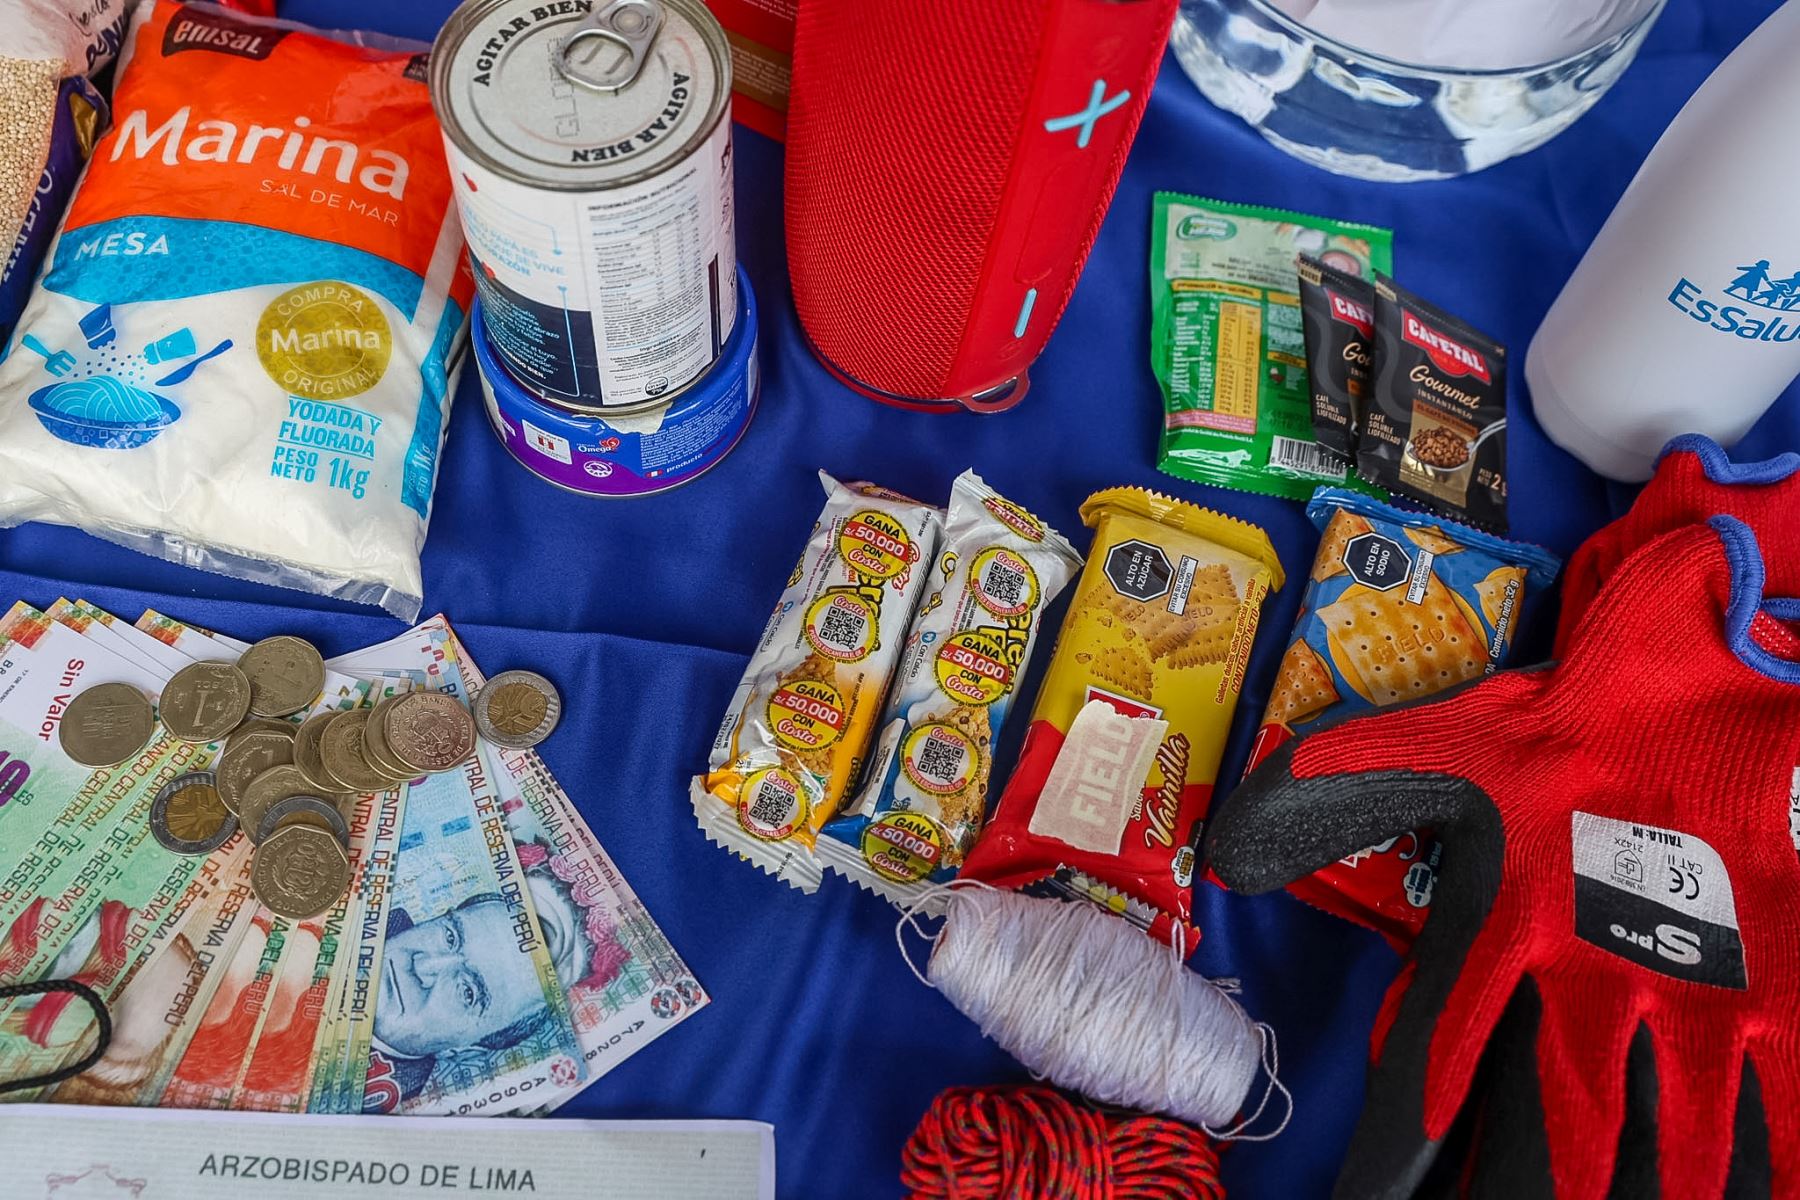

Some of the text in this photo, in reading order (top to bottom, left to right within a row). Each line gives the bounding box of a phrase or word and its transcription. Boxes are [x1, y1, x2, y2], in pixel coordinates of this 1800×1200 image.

[474, 17, 530, 86] AGITAR
[534, 0, 592, 20] BIEN
[571, 71, 690, 162] AGITAR BIEN
[110, 107, 410, 200] Marina
[259, 178, 399, 227] SAL DE MAR
[74, 232, 170, 262] MESA
[276, 286, 364, 316] COMPRA
[271, 324, 382, 354] Marina
[1407, 316, 1484, 373] CAFETAL
[283, 366, 377, 394] ORIGINAL
[1408, 364, 1482, 410] Gourmet
[287, 398, 382, 436] YODADA Y
[1315, 400, 1340, 415] SOLUBLE
[1369, 411, 1386, 424] CAFÉ
[278, 421, 375, 458] FLUORADA
[1367, 429, 1401, 446] LIOFILIZADO
[1368, 420, 1394, 435] SOLUBLE
[273, 446, 318, 467] PESO
[270, 461, 316, 483] NETO
[328, 457, 371, 499] 1kg
[1490, 474, 1501, 490] 2
[855, 526, 904, 556] 50,000
[864, 515, 901, 539] GANA
[848, 548, 886, 574] Costa
[862, 543, 884, 558] CON
[995, 552, 1025, 574] Costa
[1364, 542, 1381, 577] ALTO EN
[1376, 550, 1391, 577] SODIO
[1125, 550, 1143, 587] ALTO EN
[1136, 555, 1154, 590] AZÚCAR
[1504, 586, 1516, 598] 32
[1510, 579, 1520, 587] g
[834, 595, 865, 617] Costa
[1232, 605, 1250, 633] artificial
[1501, 598, 1513, 617] neto
[919, 644, 928, 657] Con
[962, 637, 1000, 660] GANA
[1228, 633, 1242, 653] sabor
[1488, 616, 1509, 658] Contenido
[952, 650, 1005, 679] 50,000
[959, 669, 982, 684] CON
[1221, 652, 1237, 676] dulces
[1225, 634, 1256, 693] CONTENIDO
[39, 658, 85, 741] Sin Valor
[795, 683, 836, 705] GANA
[945, 674, 985, 700] Costa
[1214, 676, 1231, 704] Galletas
[785, 695, 839, 724] 50,000
[792, 713, 814, 728] CON
[777, 718, 817, 745] Costa
[931, 727, 964, 747] Costa
[766, 770, 795, 793] Costa
[1071, 720, 1134, 826] FIELD
[80, 775, 136, 832] CENTRAL
[1145, 732, 1191, 848] Vainilla
[0, 769, 111, 911] CENTRAL DE RESER
[105, 827, 130, 851] DE
[506, 755, 530, 780] DE
[518, 775, 564, 837] RESERVA
[553, 831, 580, 863] DEL
[572, 858, 606, 899] PERÚ
[894, 817, 933, 841] GANA
[1632, 826, 1683, 848] TALLA: M
[881, 826, 936, 859] 50,000
[887, 846, 911, 862] CON
[1614, 837, 1644, 853] 2142X
[370, 849, 390, 870] DE
[872, 852, 912, 878] Costa
[1667, 854, 1703, 875] CAT II
[54, 849, 112, 914] RESERVA
[474, 795, 542, 955] DE RESERVA DEL PERÚ
[1669, 867, 1701, 900] CE
[141, 857, 197, 923] RESERVA
[203, 881, 250, 948] RESERVA
[360, 873, 386, 941] RESERVA
[30, 914, 62, 942] DEL
[119, 924, 149, 952] DEL
[163, 981, 200, 1027] PERÚ
[242, 970, 275, 1016] PERÚ
[303, 975, 330, 1020] PERÚ
[583, 1018, 645, 1062] A7028
[200, 1154, 537, 1192] ARZOBISPADO DE LIMA
